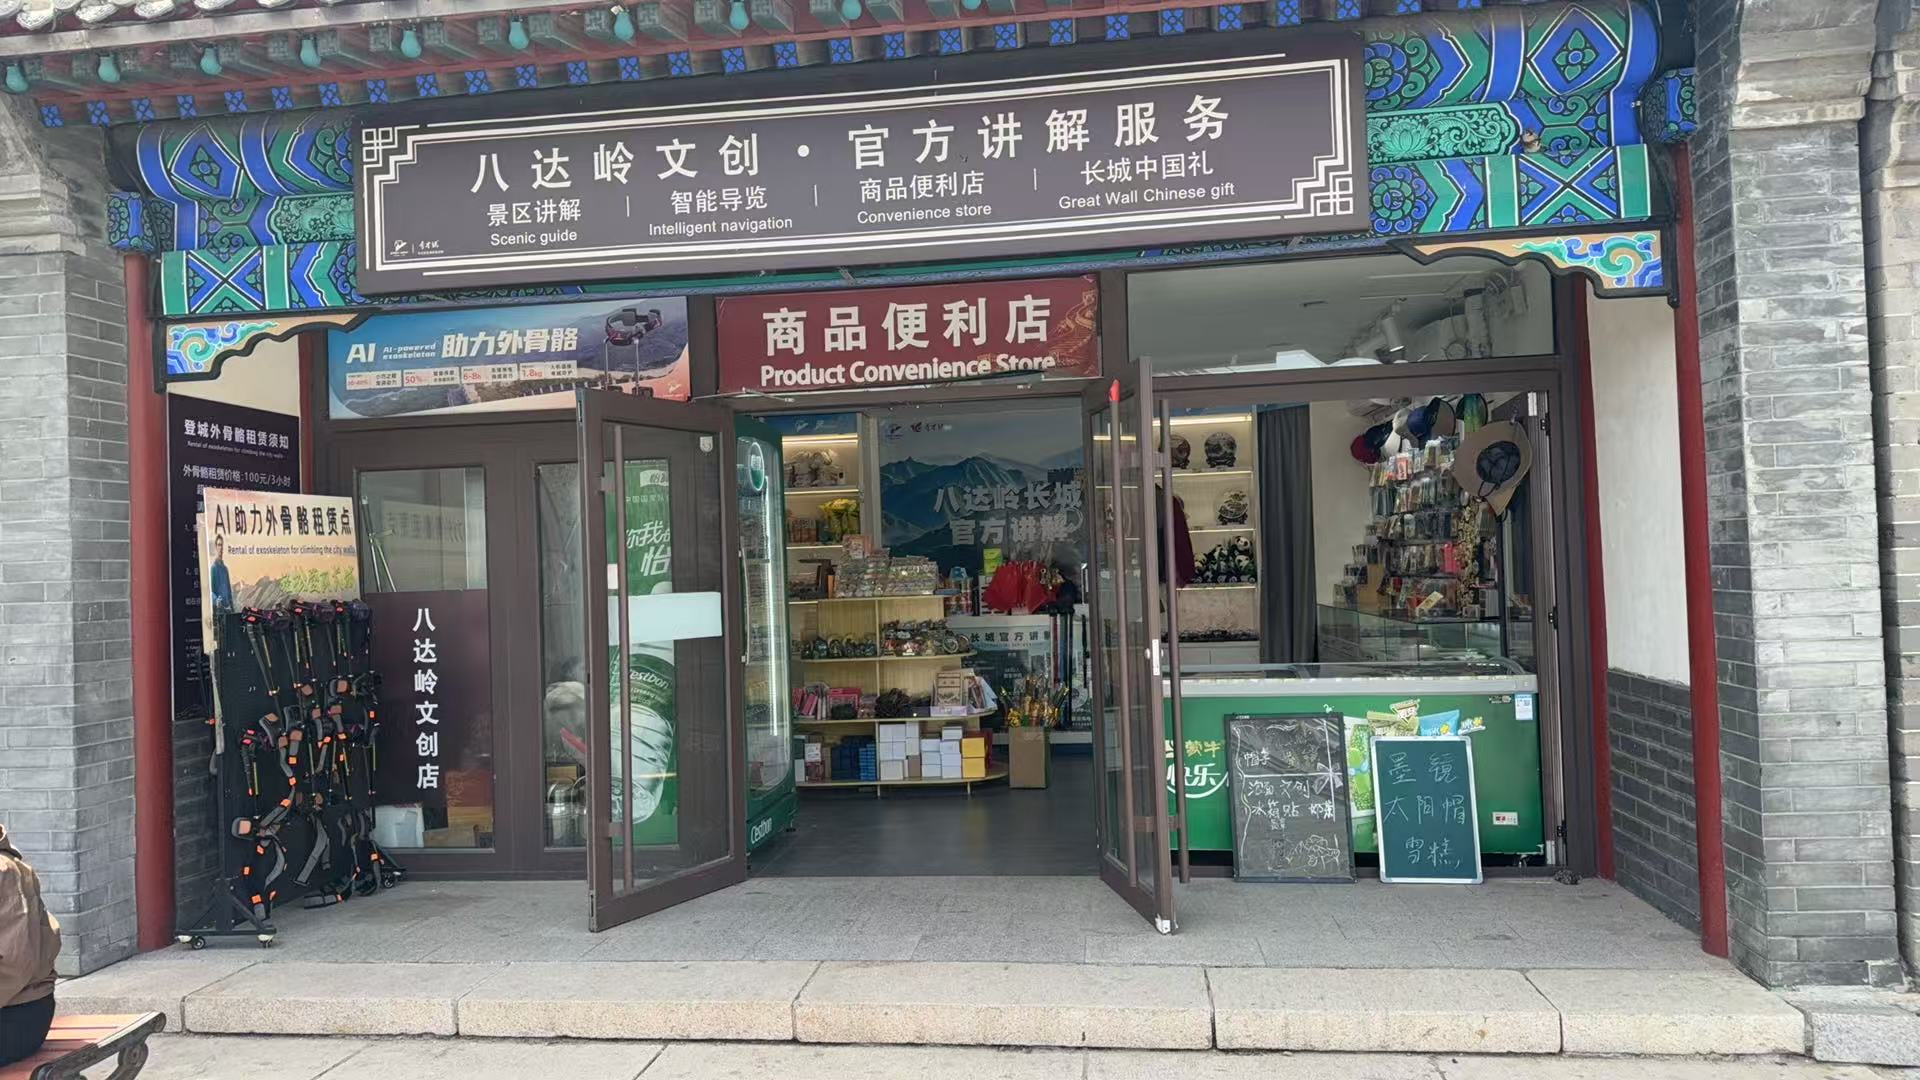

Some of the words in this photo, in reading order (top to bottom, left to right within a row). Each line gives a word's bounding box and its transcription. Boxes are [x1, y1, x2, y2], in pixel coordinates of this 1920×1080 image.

[1080, 149, 1214, 187] 长城中国礼
[670, 185, 768, 216] 智能导览
[859, 171, 985, 203] 商品便利店
[1058, 192, 1100, 210] Great
[1104, 189, 1138, 206] Wall
[1143, 184, 1206, 204] Chinese
[1210, 182, 1236, 201] gift
[486, 197, 582, 227] 景区讲解
[649, 219, 717, 237] Intelligent
[721, 216, 794, 235] navigation
[857, 206, 952, 224] Convenience
[955, 202, 992, 219] store
[490, 230, 536, 247] Scenic
[540, 228, 578, 246] guide
[762, 294, 1052, 356] 商品便利店
[346, 343, 377, 364] AI
[441, 327, 579, 359] 助力外骨骼
[760, 362, 846, 387] Product
[850, 356, 992, 382] Convenience
[996, 353, 1057, 372] Store
[184, 418, 289, 449] 登城外骨骼租赁须知
[933, 480, 1082, 513] 八达岭长城
[215, 503, 352, 537] AI助力外骨骼租赁点
[950, 515, 1068, 546] 官方讲解
[227, 545, 248, 555] Rental
[249, 545, 255, 555] of
[291, 545, 300, 555] for
[629, 668, 669, 690] estbon
[412, 607, 440, 790] 八达岭文创店
[1184, 739, 1222, 758] 蒙牛
[1388, 751, 1458, 785] 墨镜
[1251, 798, 1300, 819] 冰箱贴
[1382, 794, 1466, 825] 太阳帽
[750, 817, 772, 844] Cestbon
[1404, 836, 1461, 869] 雪糕
